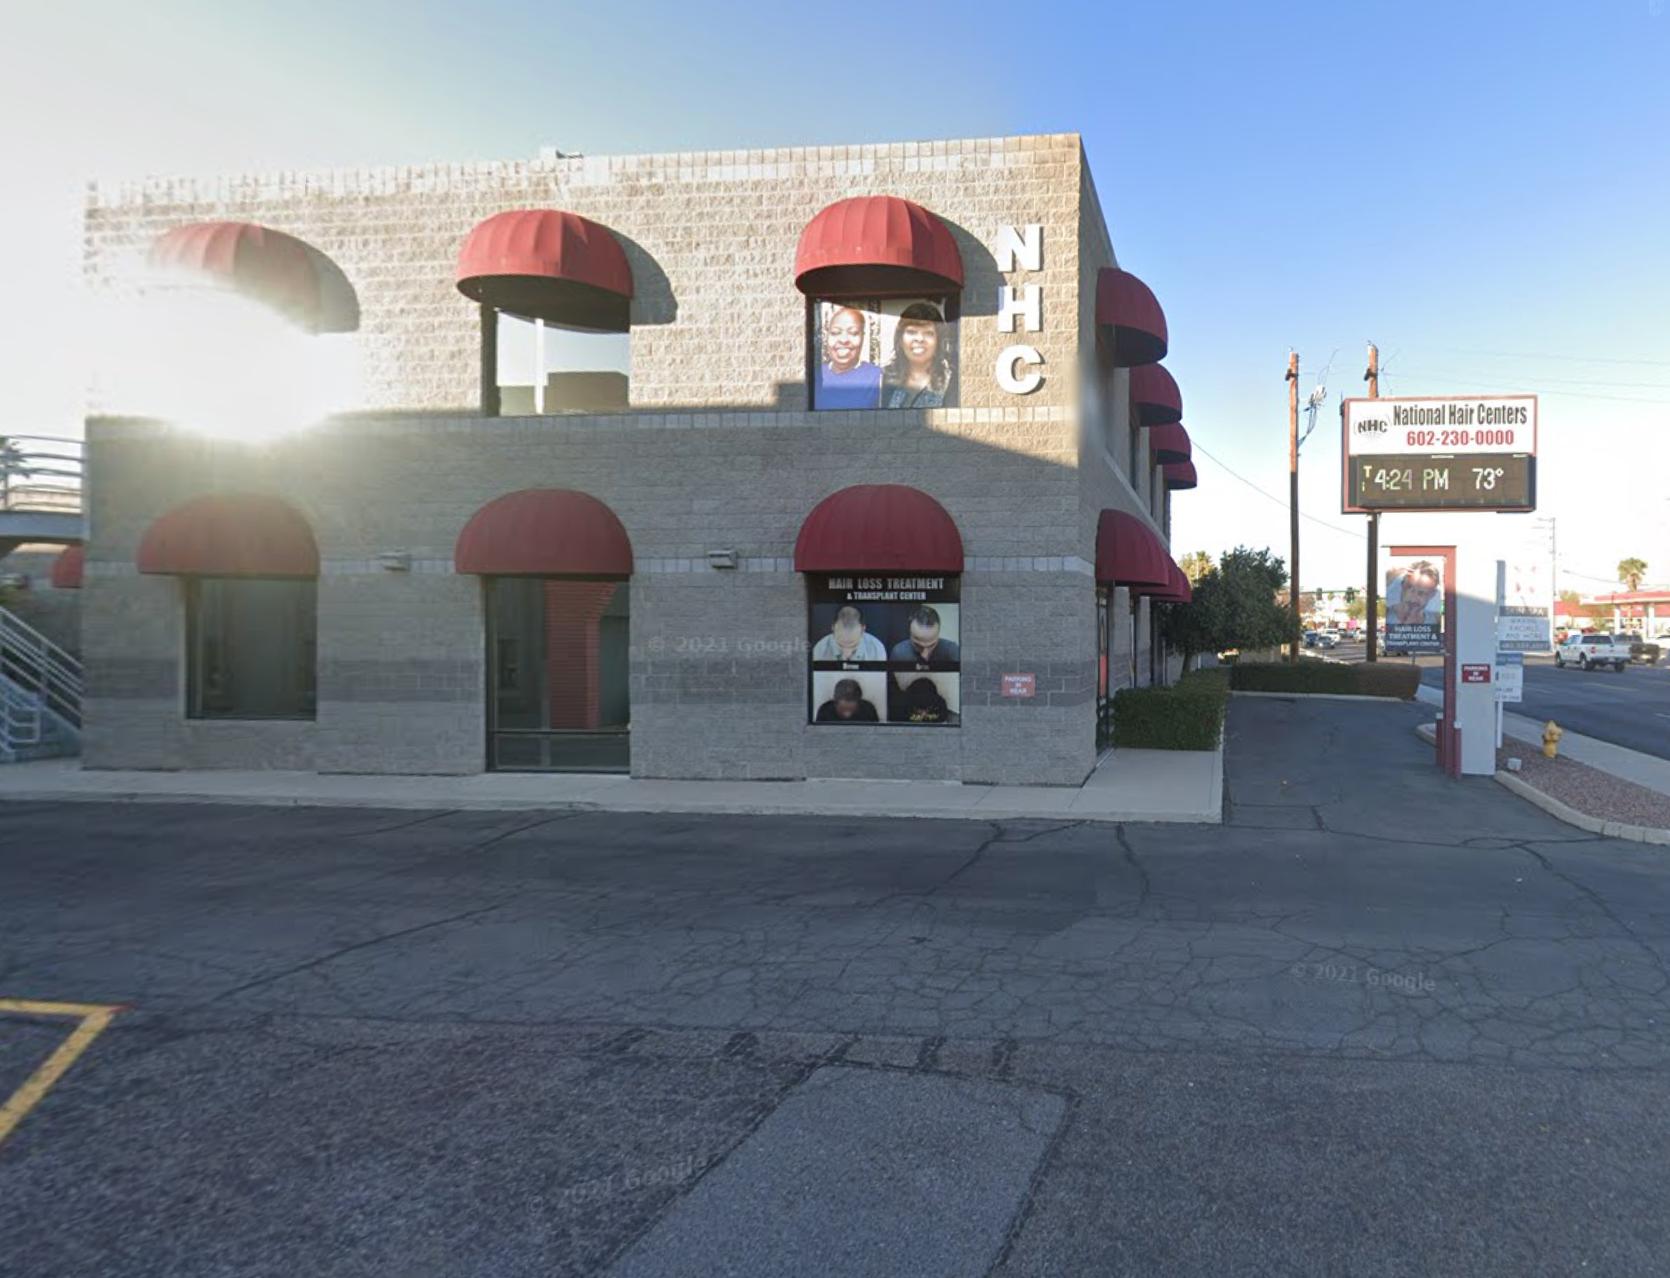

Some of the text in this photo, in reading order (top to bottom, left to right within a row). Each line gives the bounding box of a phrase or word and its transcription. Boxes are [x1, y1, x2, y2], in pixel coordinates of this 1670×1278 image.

[996, 224, 1043, 395] NHC
[1393, 403, 1527, 426] National Hair Centers
[1357, 419, 1388, 433] NHC
[1406, 430, 1515, 446] 602-230-0000
[1374, 467, 1505, 491] 4:24 PM 73°
[828, 577, 945, 590] HAIR LOSS TREATMENT
[854, 591, 898, 600] TRANSPLANT
[899, 591, 926, 600] CENTER
